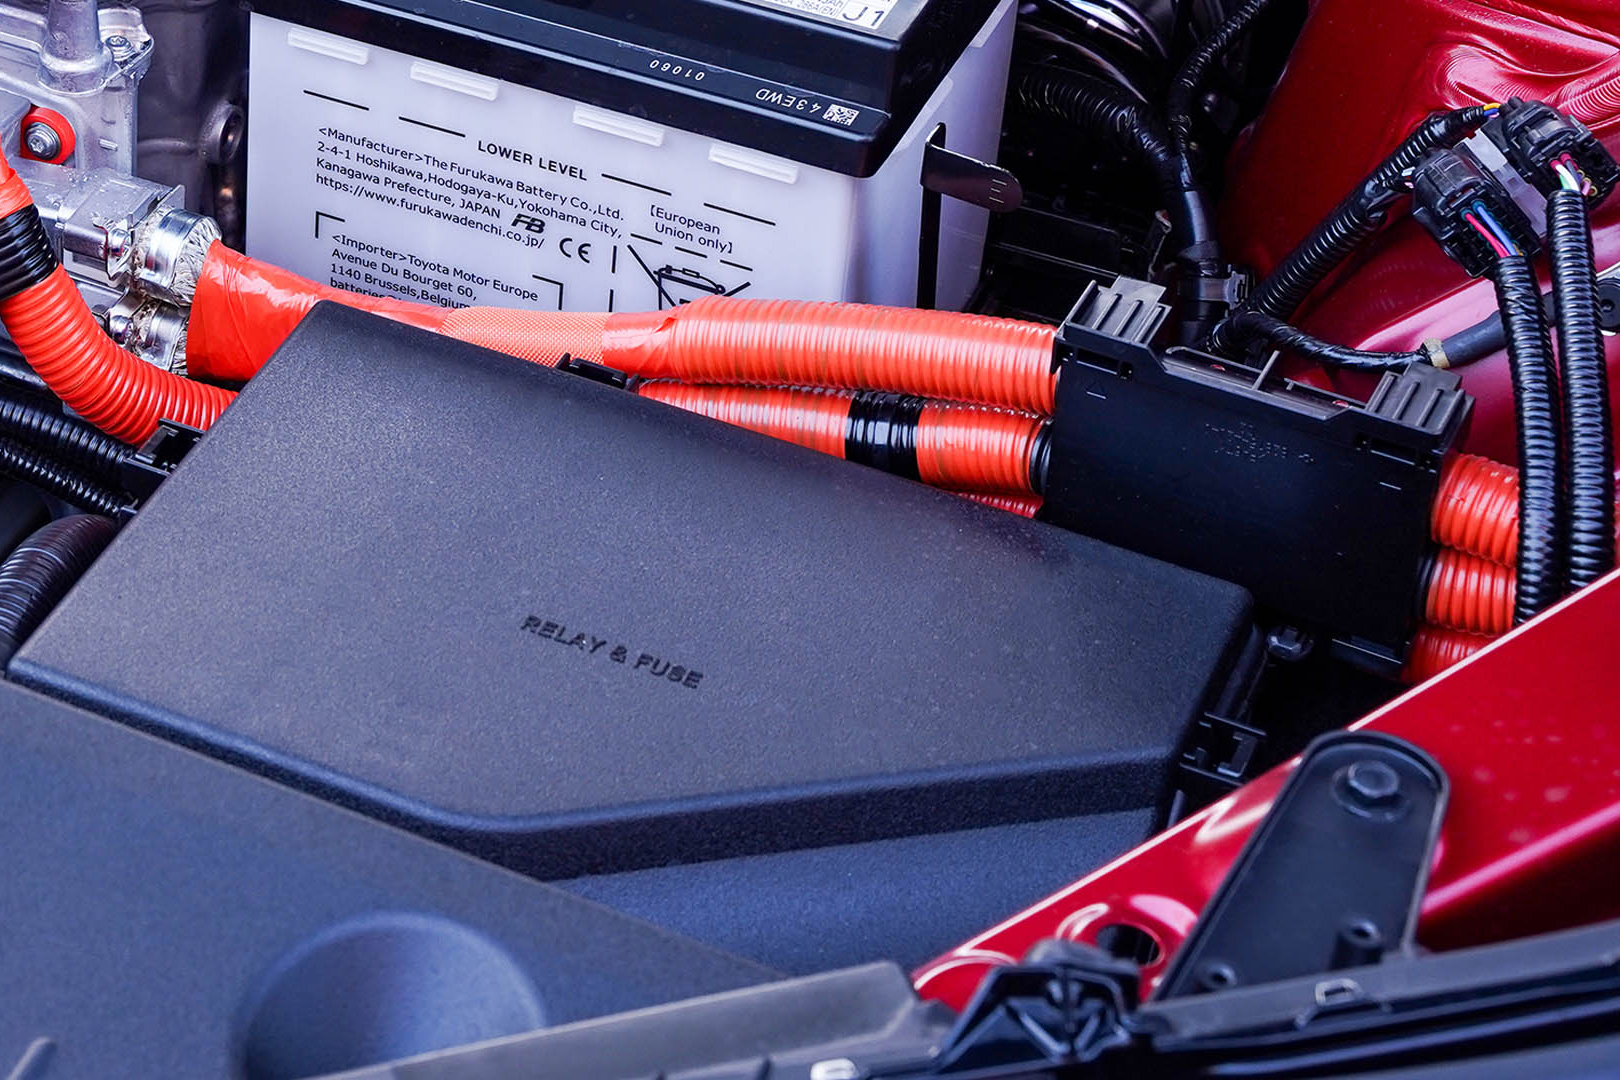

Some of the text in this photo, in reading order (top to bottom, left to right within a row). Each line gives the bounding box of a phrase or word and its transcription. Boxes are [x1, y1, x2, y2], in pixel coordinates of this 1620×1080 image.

[478, 140, 587, 181] LOWER LEVEL
[316, 157, 501, 219] Kanagawa Prefecture, JAPAN
[316, 173, 545, 249] https://www.furukawadenchi.co.jp/
[317, 141, 351, 160] 2-4-1
[591, 220, 622, 239] City,
[449, 162, 514, 189] Furukawa
[516, 181, 568, 206] Battery
[570, 197, 624, 221] Co.,Ltd.
[559, 237, 592, 264] CE
[655, 222, 694, 243] Union
[331, 263, 361, 281] 1140
[332, 248, 477, 302] Avenue Du Bourget 60,
[452, 267, 490, 287] Motor
[493, 280, 539, 302] Europe
[520, 615, 704, 690] RELAY & FUSE
